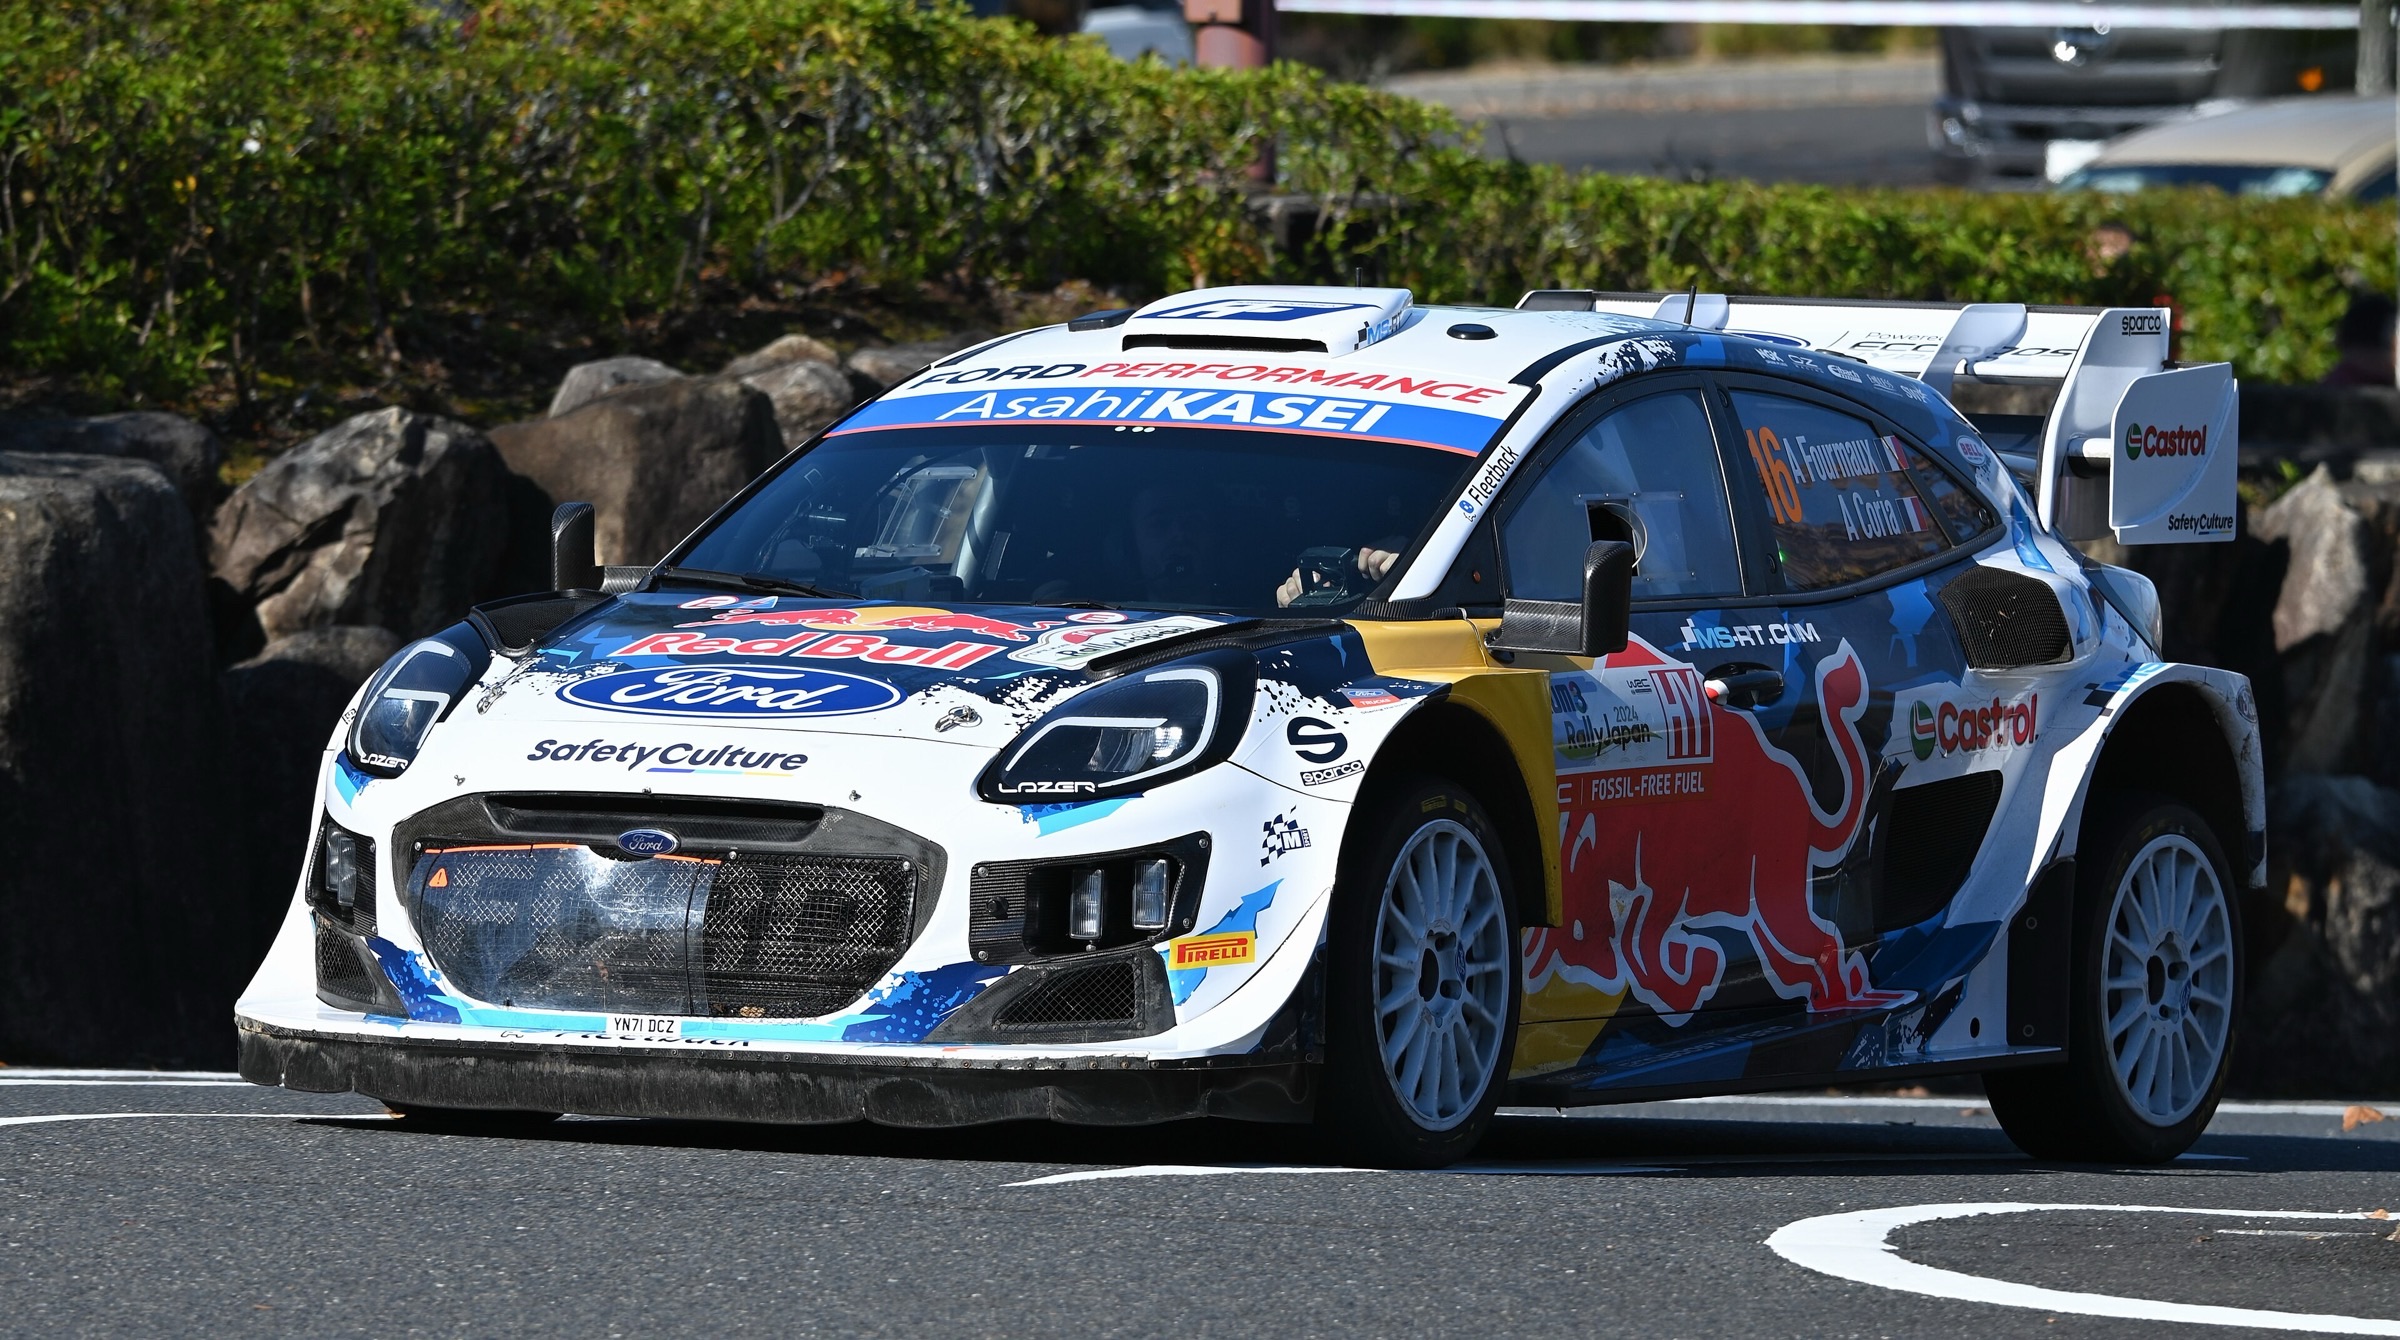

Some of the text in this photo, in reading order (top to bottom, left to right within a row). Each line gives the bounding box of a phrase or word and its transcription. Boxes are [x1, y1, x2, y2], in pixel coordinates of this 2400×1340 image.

[2121, 315, 2161, 336] sparco
[907, 363, 1507, 404] FORD PERFORMANCE
[1959, 443, 1984, 457] BELL
[2143, 424, 2207, 457] Castrol
[1468, 445, 1519, 506] Fleetback
[1745, 426, 1880, 525] 16 A Fourmaux
[1838, 489, 1901, 541] A Coria
[2168, 513, 2233, 535] SafetyCulture
[622, 632, 815, 656] Red
[798, 634, 1000, 669] Bull
[609, 667, 839, 711] Ford
[1613, 705, 1639, 722] 2024
[1651, 671, 1702, 757] HY
[1937, 693, 2037, 752] Castrol
[527, 739, 809, 771] SafetyCulture
[998, 782, 1096, 793] LAZER
[1303, 761, 1364, 785] sparco
[1591, 771, 1705, 801] FOSSIL-FREE FUEL
[628, 832, 665, 853] Ford
[1176, 937, 1248, 964] PIRELLI
[614, 1017, 675, 1034] YN71 DCZ
